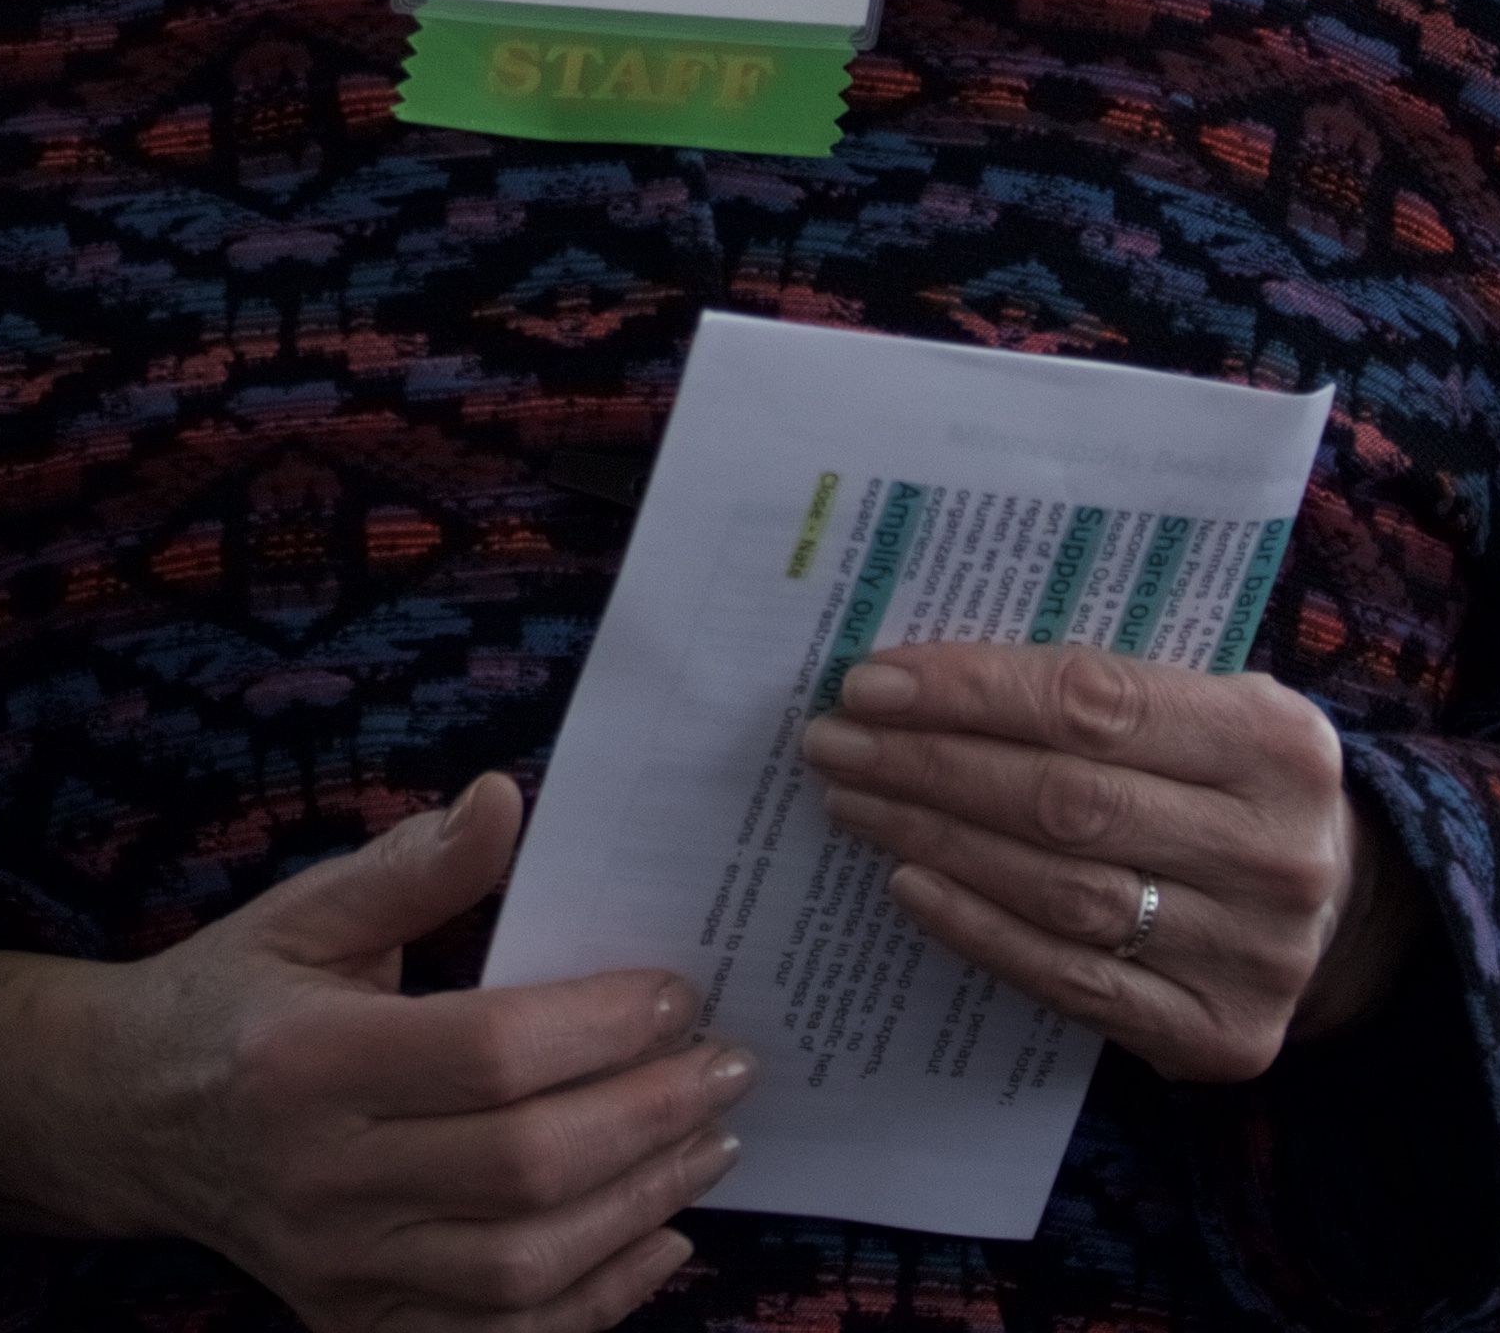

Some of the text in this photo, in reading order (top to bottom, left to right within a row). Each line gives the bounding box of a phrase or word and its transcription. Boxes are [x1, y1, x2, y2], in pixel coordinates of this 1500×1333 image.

[488, 38, 777, 111] STAFF
[809, 472, 838, 519] Close
[850, 478, 882, 541] expand
[859, 483, 920, 588] Amplify
[963, 493, 995, 554] Human
[992, 496, 1017, 542] when
[1009, 499, 1041, 559] regular
[1044, 502, 1064, 535] sort
[1101, 510, 1129, 561] Reach
[1191, 519, 1212, 554] New
[1256, 518, 1283, 563] our
[839, 548, 858, 574] our
[922, 489, 970, 595] organization
[981, 548, 998, 572] we
[1036, 541, 1052, 557] of
[1039, 505, 1101, 619] Support
[1110, 512, 1151, 595] becoming
[1137, 515, 1186, 599] Share
[1216, 520, 1256, 599] Examples
[1028, 564, 1041, 574] a
[1087, 567, 1108, 597] Out
[1164, 560, 1197, 619] Prague
[913, 600, 931, 617] to
[964, 578, 987, 619] need
[1012, 580, 1037, 623] brain
[1072, 604, 1093, 634] and
[1105, 600, 1117, 609] a
[1209, 605, 1224, 621] of
[843, 599, 873, 644] our
[1119, 603, 1148, 648] our
[1202, 627, 1212, 636] a
[769, 706, 800, 760] Online
[738, 766, 779, 846] donations
[763, 781, 799, 850] financial
[733, 856, 772, 929] donation
[806, 843, 836, 900] benefit
[824, 865, 854, 916] taking
[698, 863, 739, 946] envelopes
[841, 860, 878, 936] expertise
[873, 901, 890, 917] to
[725, 934, 742, 952] to
[790, 907, 814, 945] from
[819, 922, 832, 932] a
[884, 934, 902, 956] for
[773, 950, 795, 986] your
[791, 938, 828, 1008] business
[834, 944, 850, 959] in
[847, 922, 880, 982] provide
[897, 941, 923, 988] group
[698, 957, 736, 1028] maintain
[822, 963, 843, 989] the
[862, 962, 890, 1013] advice
[783, 1013, 798, 1028] or
[807, 994, 828, 1029] area
[822, 989, 856, 1047] specific
[890, 995, 906, 1010] of
[946, 985, 970, 1024] word
[692, 1033, 705, 1042] a
[798, 1035, 814, 1051] of
[846, 1031, 862, 1051] no
[862, 1015, 896, 1081] experts,
[926, 1029, 954, 1077] about
[951, 1013, 985, 1078] perhaps
[807, 1052, 832, 1087] help
[1032, 1050, 1056, 1089] Mike
